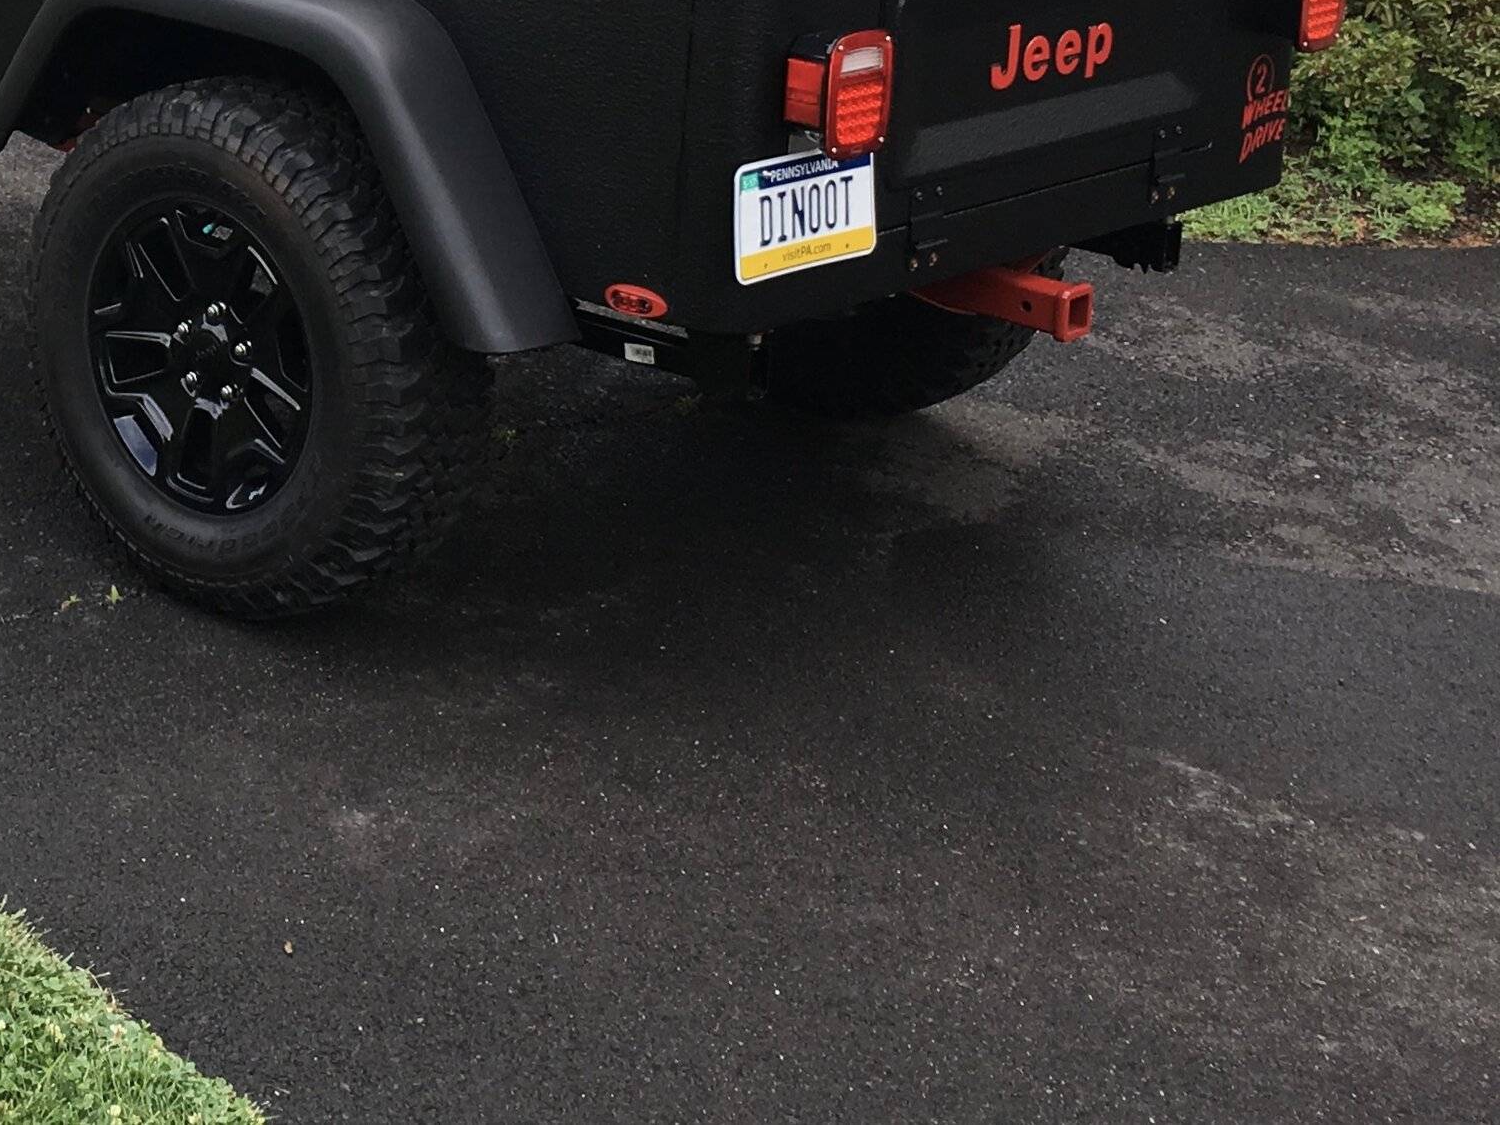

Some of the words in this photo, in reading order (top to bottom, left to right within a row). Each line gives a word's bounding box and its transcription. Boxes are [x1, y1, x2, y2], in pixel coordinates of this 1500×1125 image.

[990, 21, 1113, 91] Jeep
[1256, 63, 1268, 94] 2
[1242, 89, 1287, 130] WHEEL
[1239, 118, 1286, 164] DRIVE
[770, 158, 839, 183] PENNSYLVANIA
[759, 175, 853, 248] DINOOT
[782, 242, 832, 262] visitPA.com
